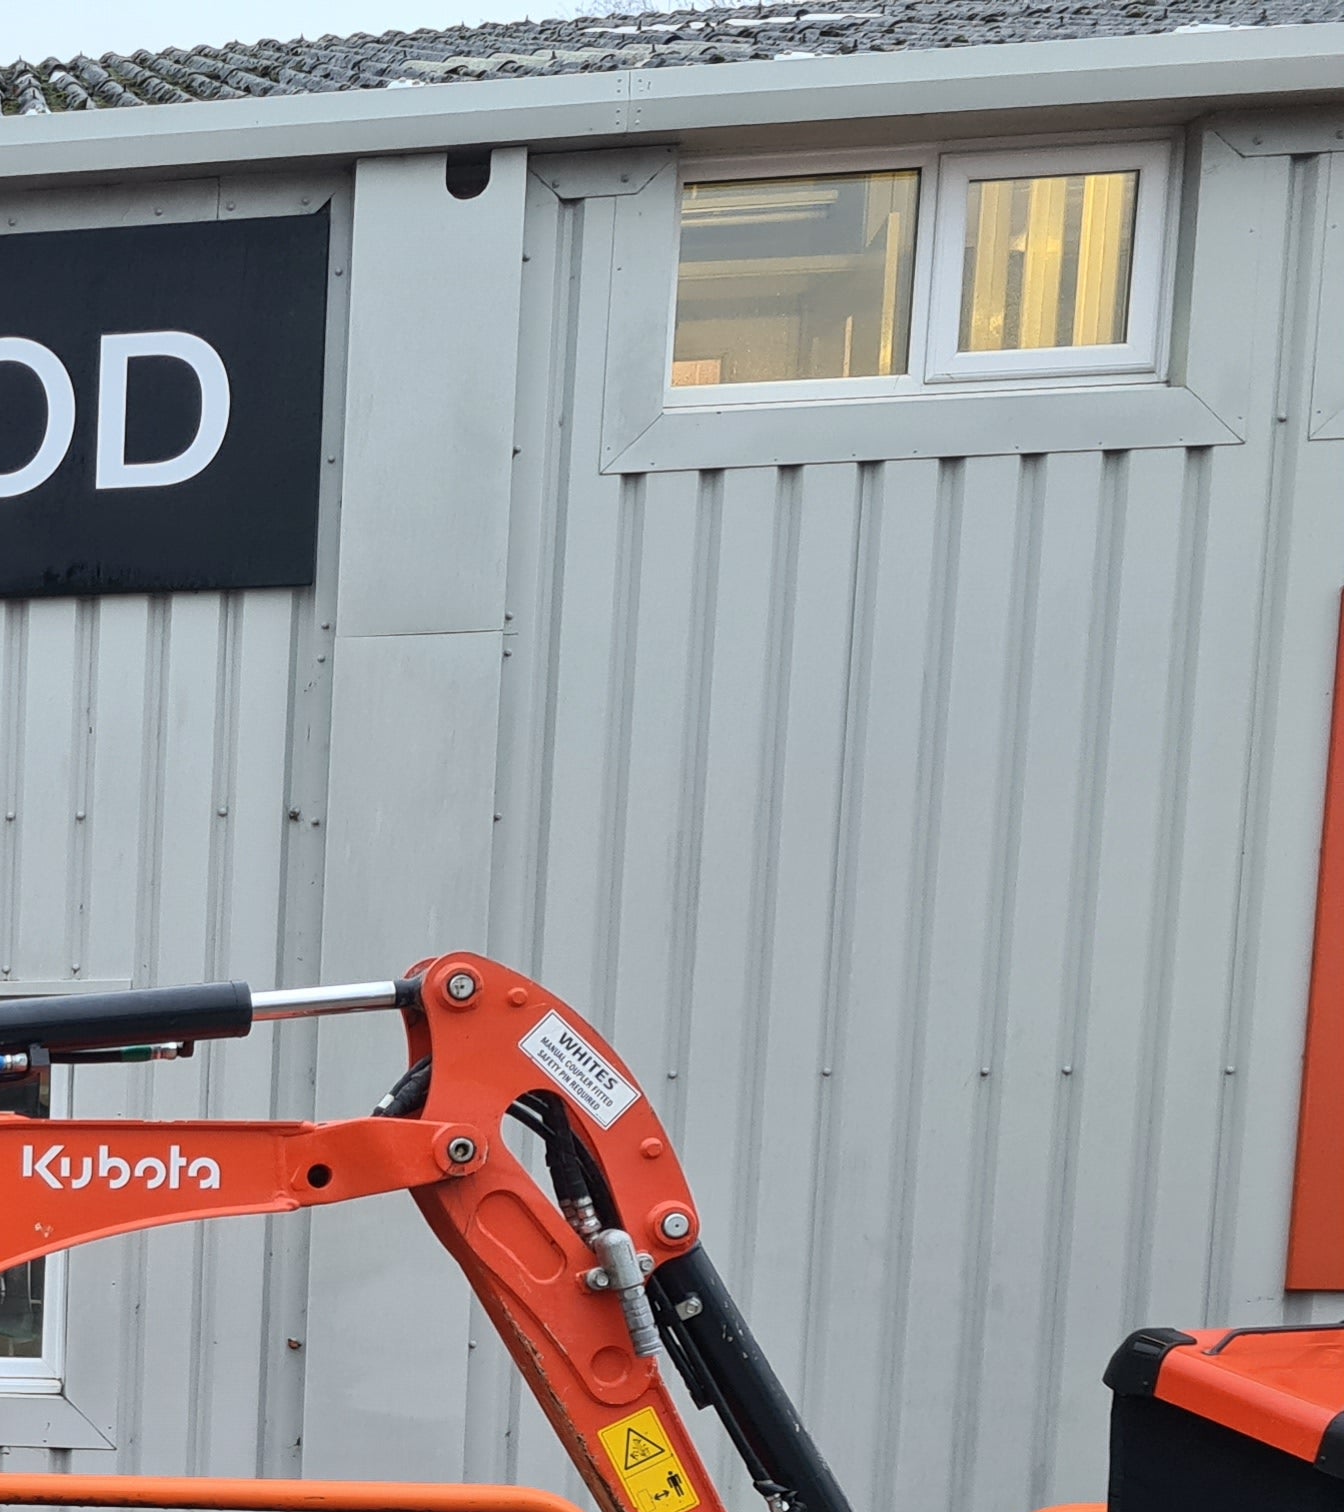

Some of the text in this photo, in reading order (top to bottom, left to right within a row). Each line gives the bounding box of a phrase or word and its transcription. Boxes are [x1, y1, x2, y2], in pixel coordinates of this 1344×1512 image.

[537, 1050, 601, 1111] SAFETY PIN REQUIRED
[540, 1036, 614, 1108] MANUAL COUPLER FITTED
[558, 1031, 618, 1091] WHITES
[21, 1144, 222, 1190] Kubota
